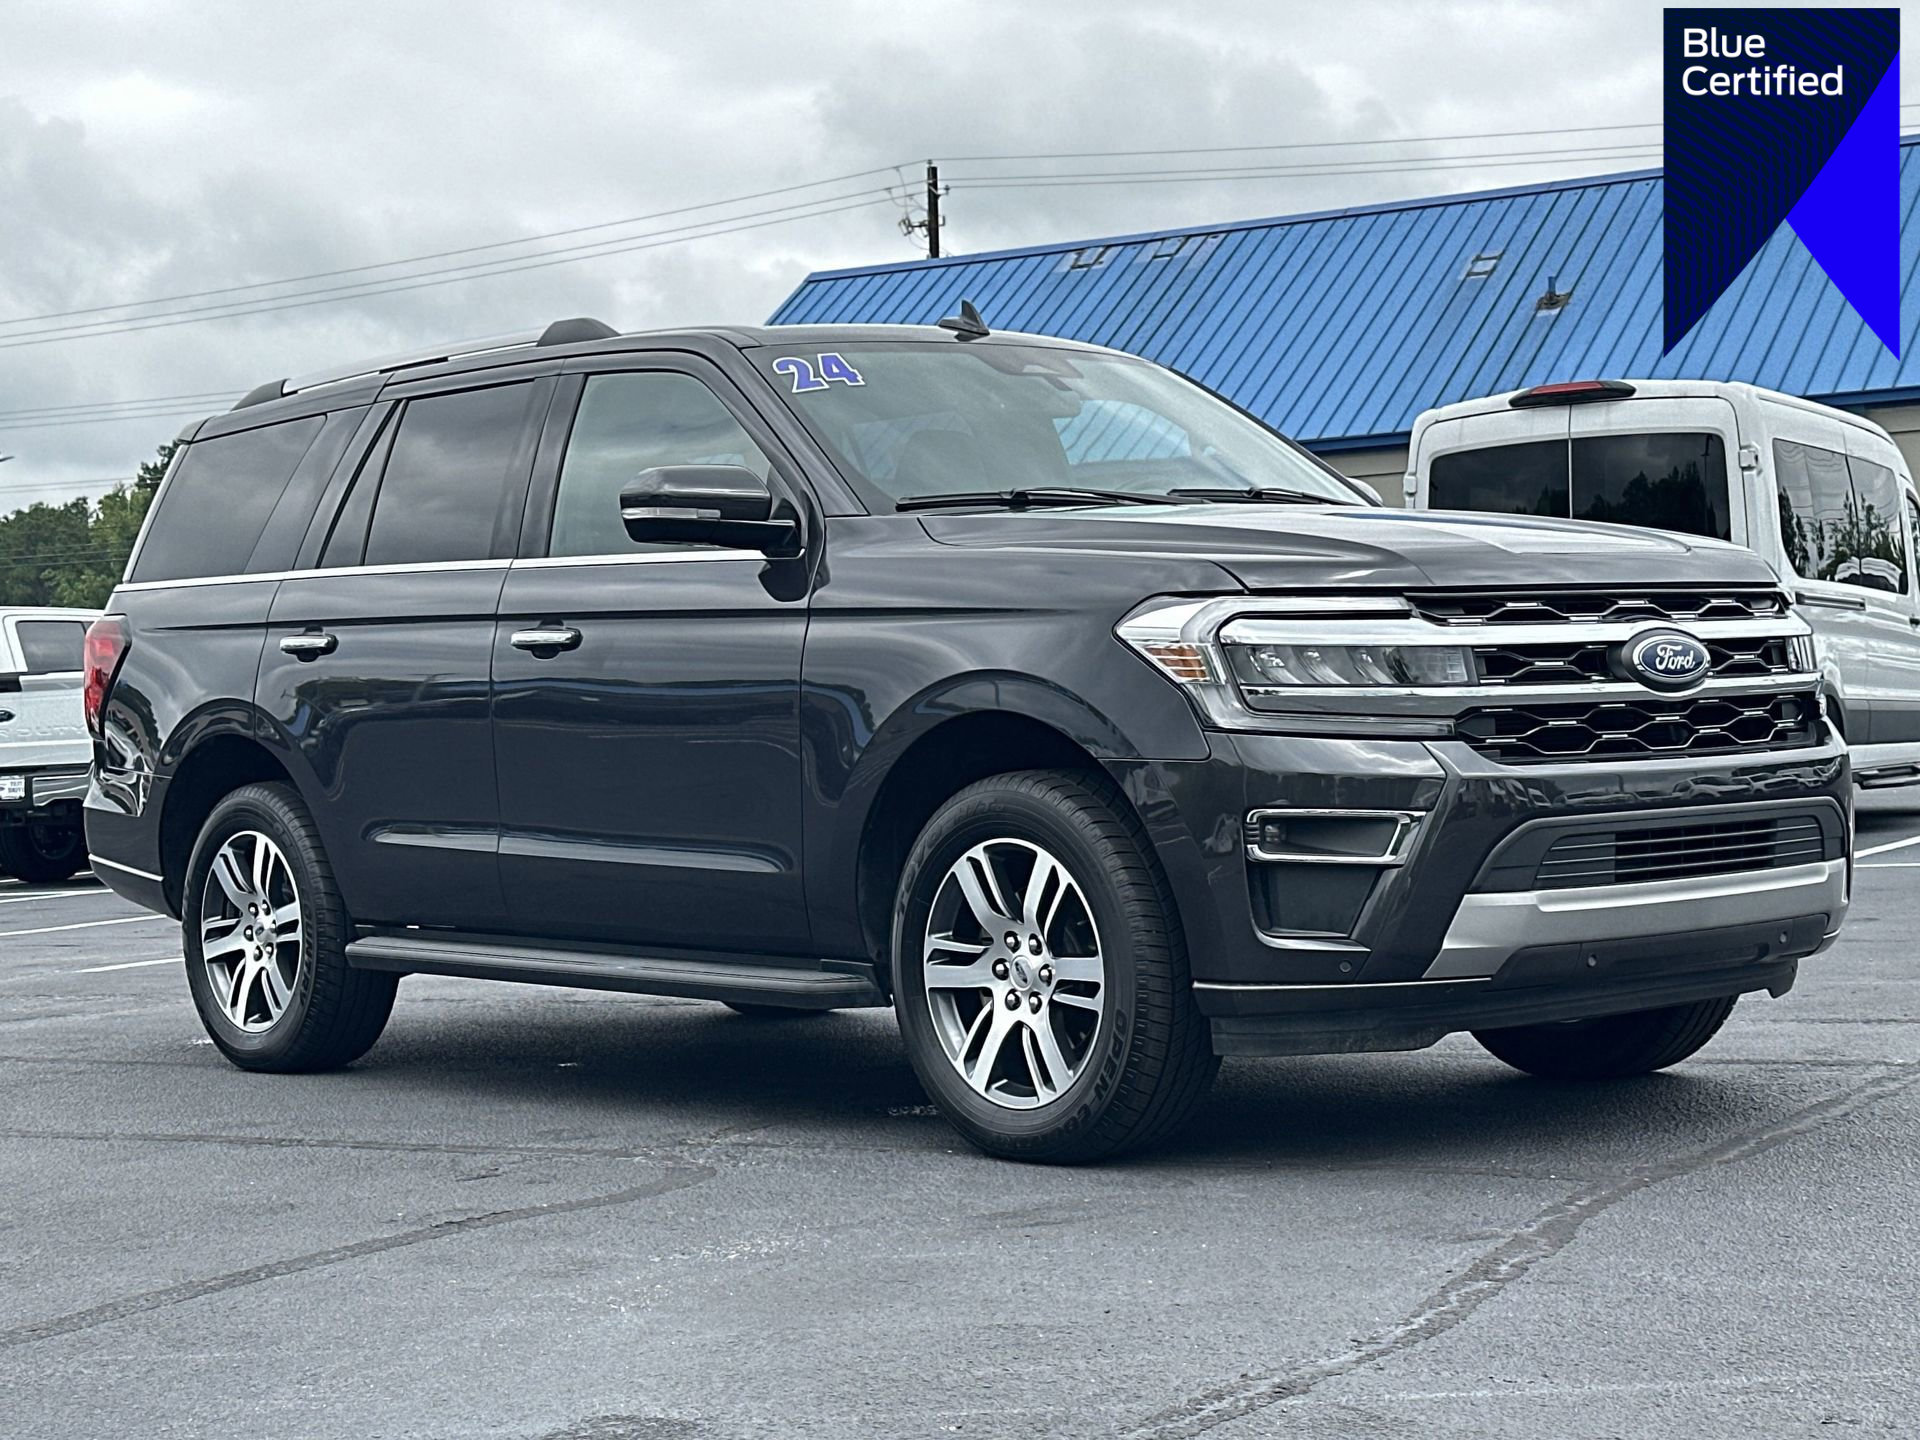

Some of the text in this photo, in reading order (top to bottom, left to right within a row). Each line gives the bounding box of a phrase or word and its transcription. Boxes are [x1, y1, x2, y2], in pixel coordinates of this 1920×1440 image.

[772, 352, 866, 393] 24
[1655, 644, 1695, 670] Ford
[1094, 1008, 1128, 1101] OPEN
